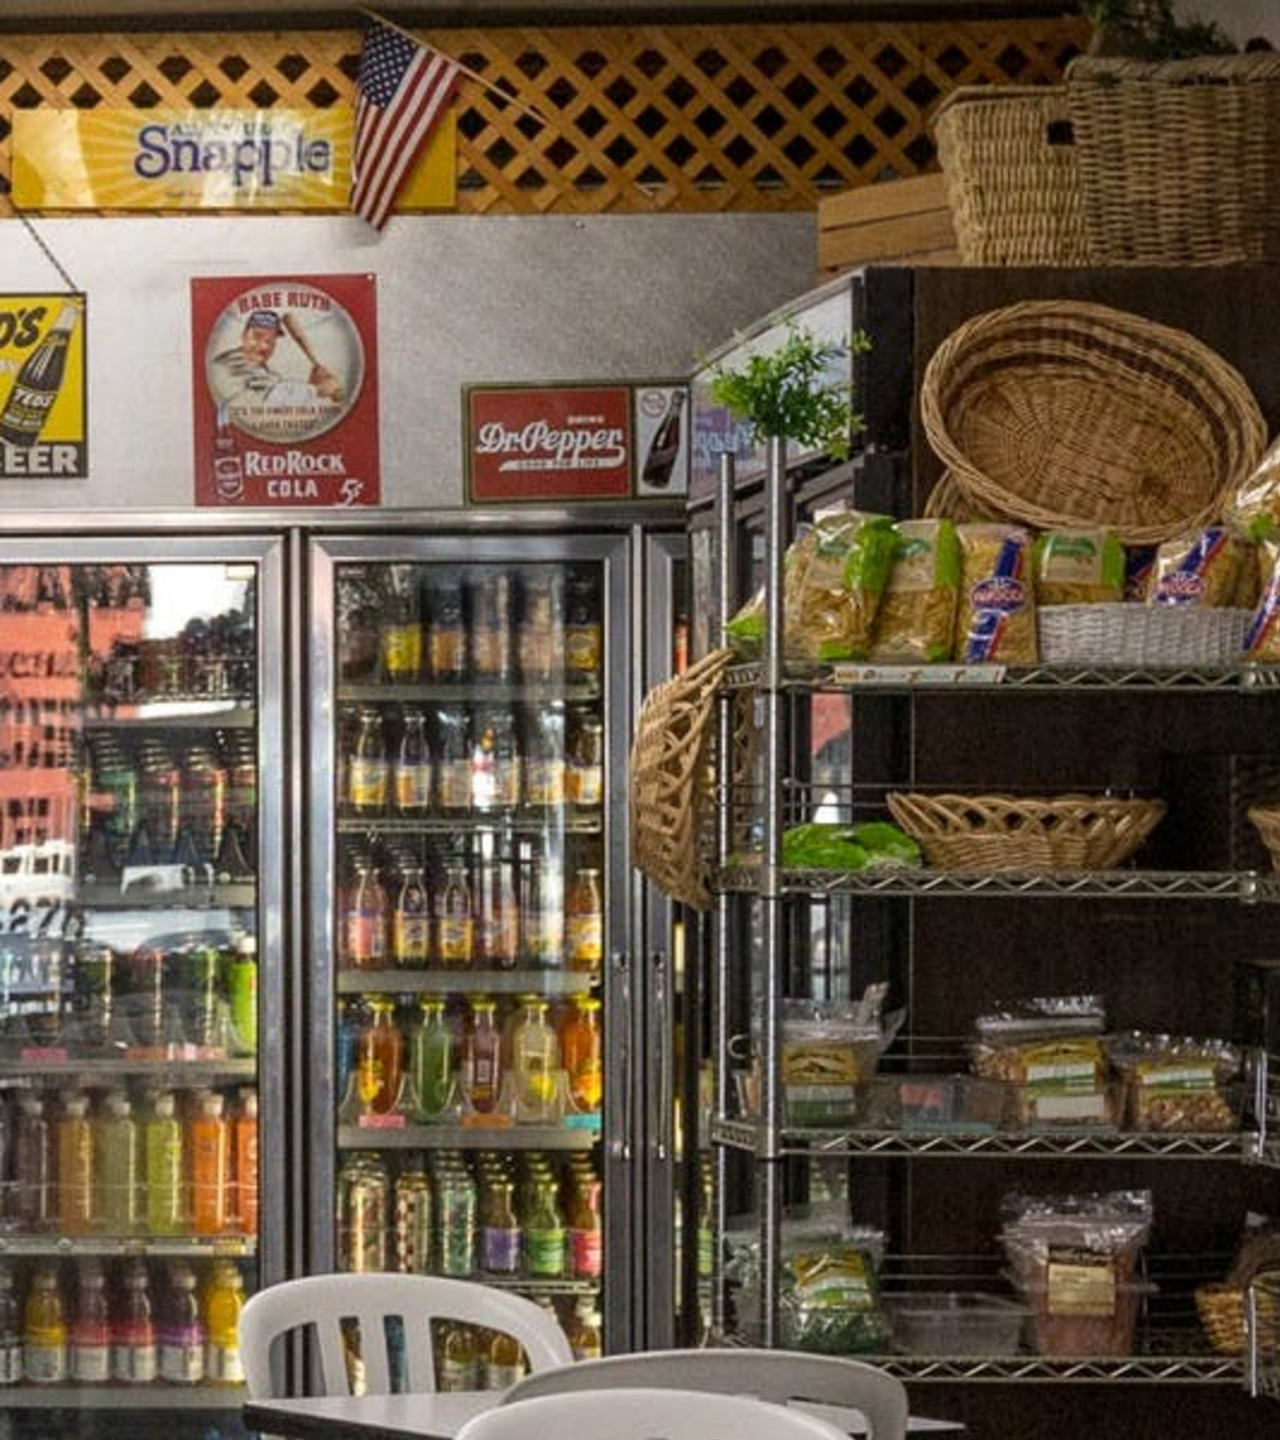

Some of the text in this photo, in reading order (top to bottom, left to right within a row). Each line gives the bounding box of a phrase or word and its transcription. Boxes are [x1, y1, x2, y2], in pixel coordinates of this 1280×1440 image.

[134, 124, 330, 187] Snapple
[238, 291, 331, 313] BABE RUTH
[520, 419, 623, 467] Pepper
[0, 445, 77, 474] EER
[267, 480, 319, 498] COLA
